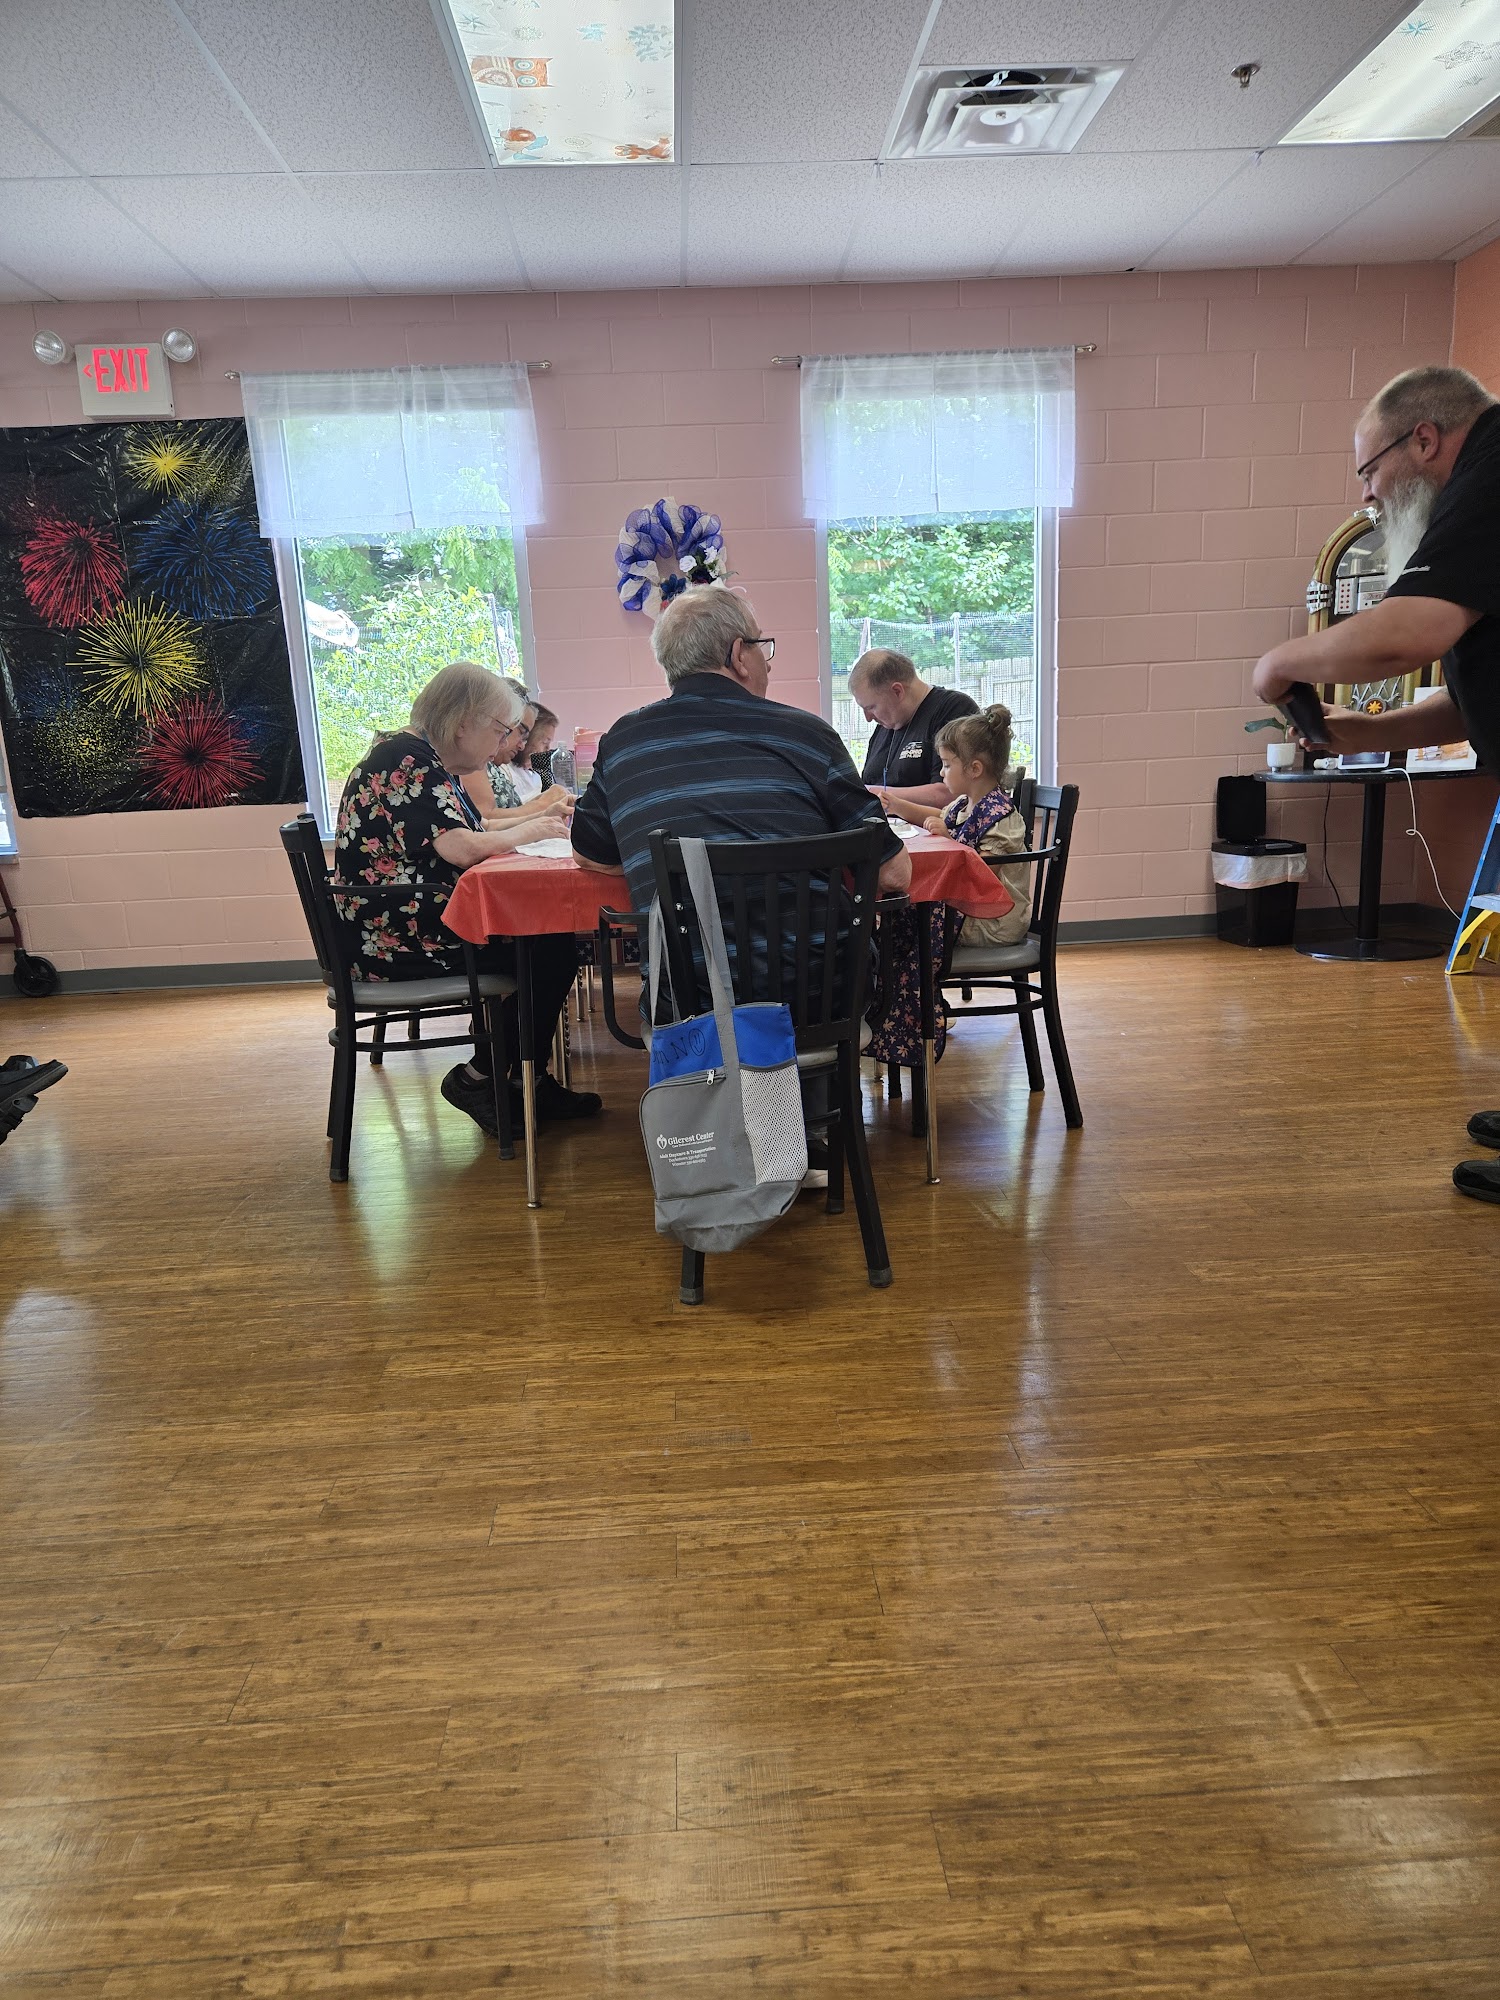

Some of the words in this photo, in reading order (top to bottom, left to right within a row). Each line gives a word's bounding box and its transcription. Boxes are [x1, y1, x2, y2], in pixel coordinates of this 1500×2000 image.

[92, 347, 149, 393] EXIT
[668, 1134, 695, 1146] Gilcrest
[695, 1131, 714, 1141] Center
